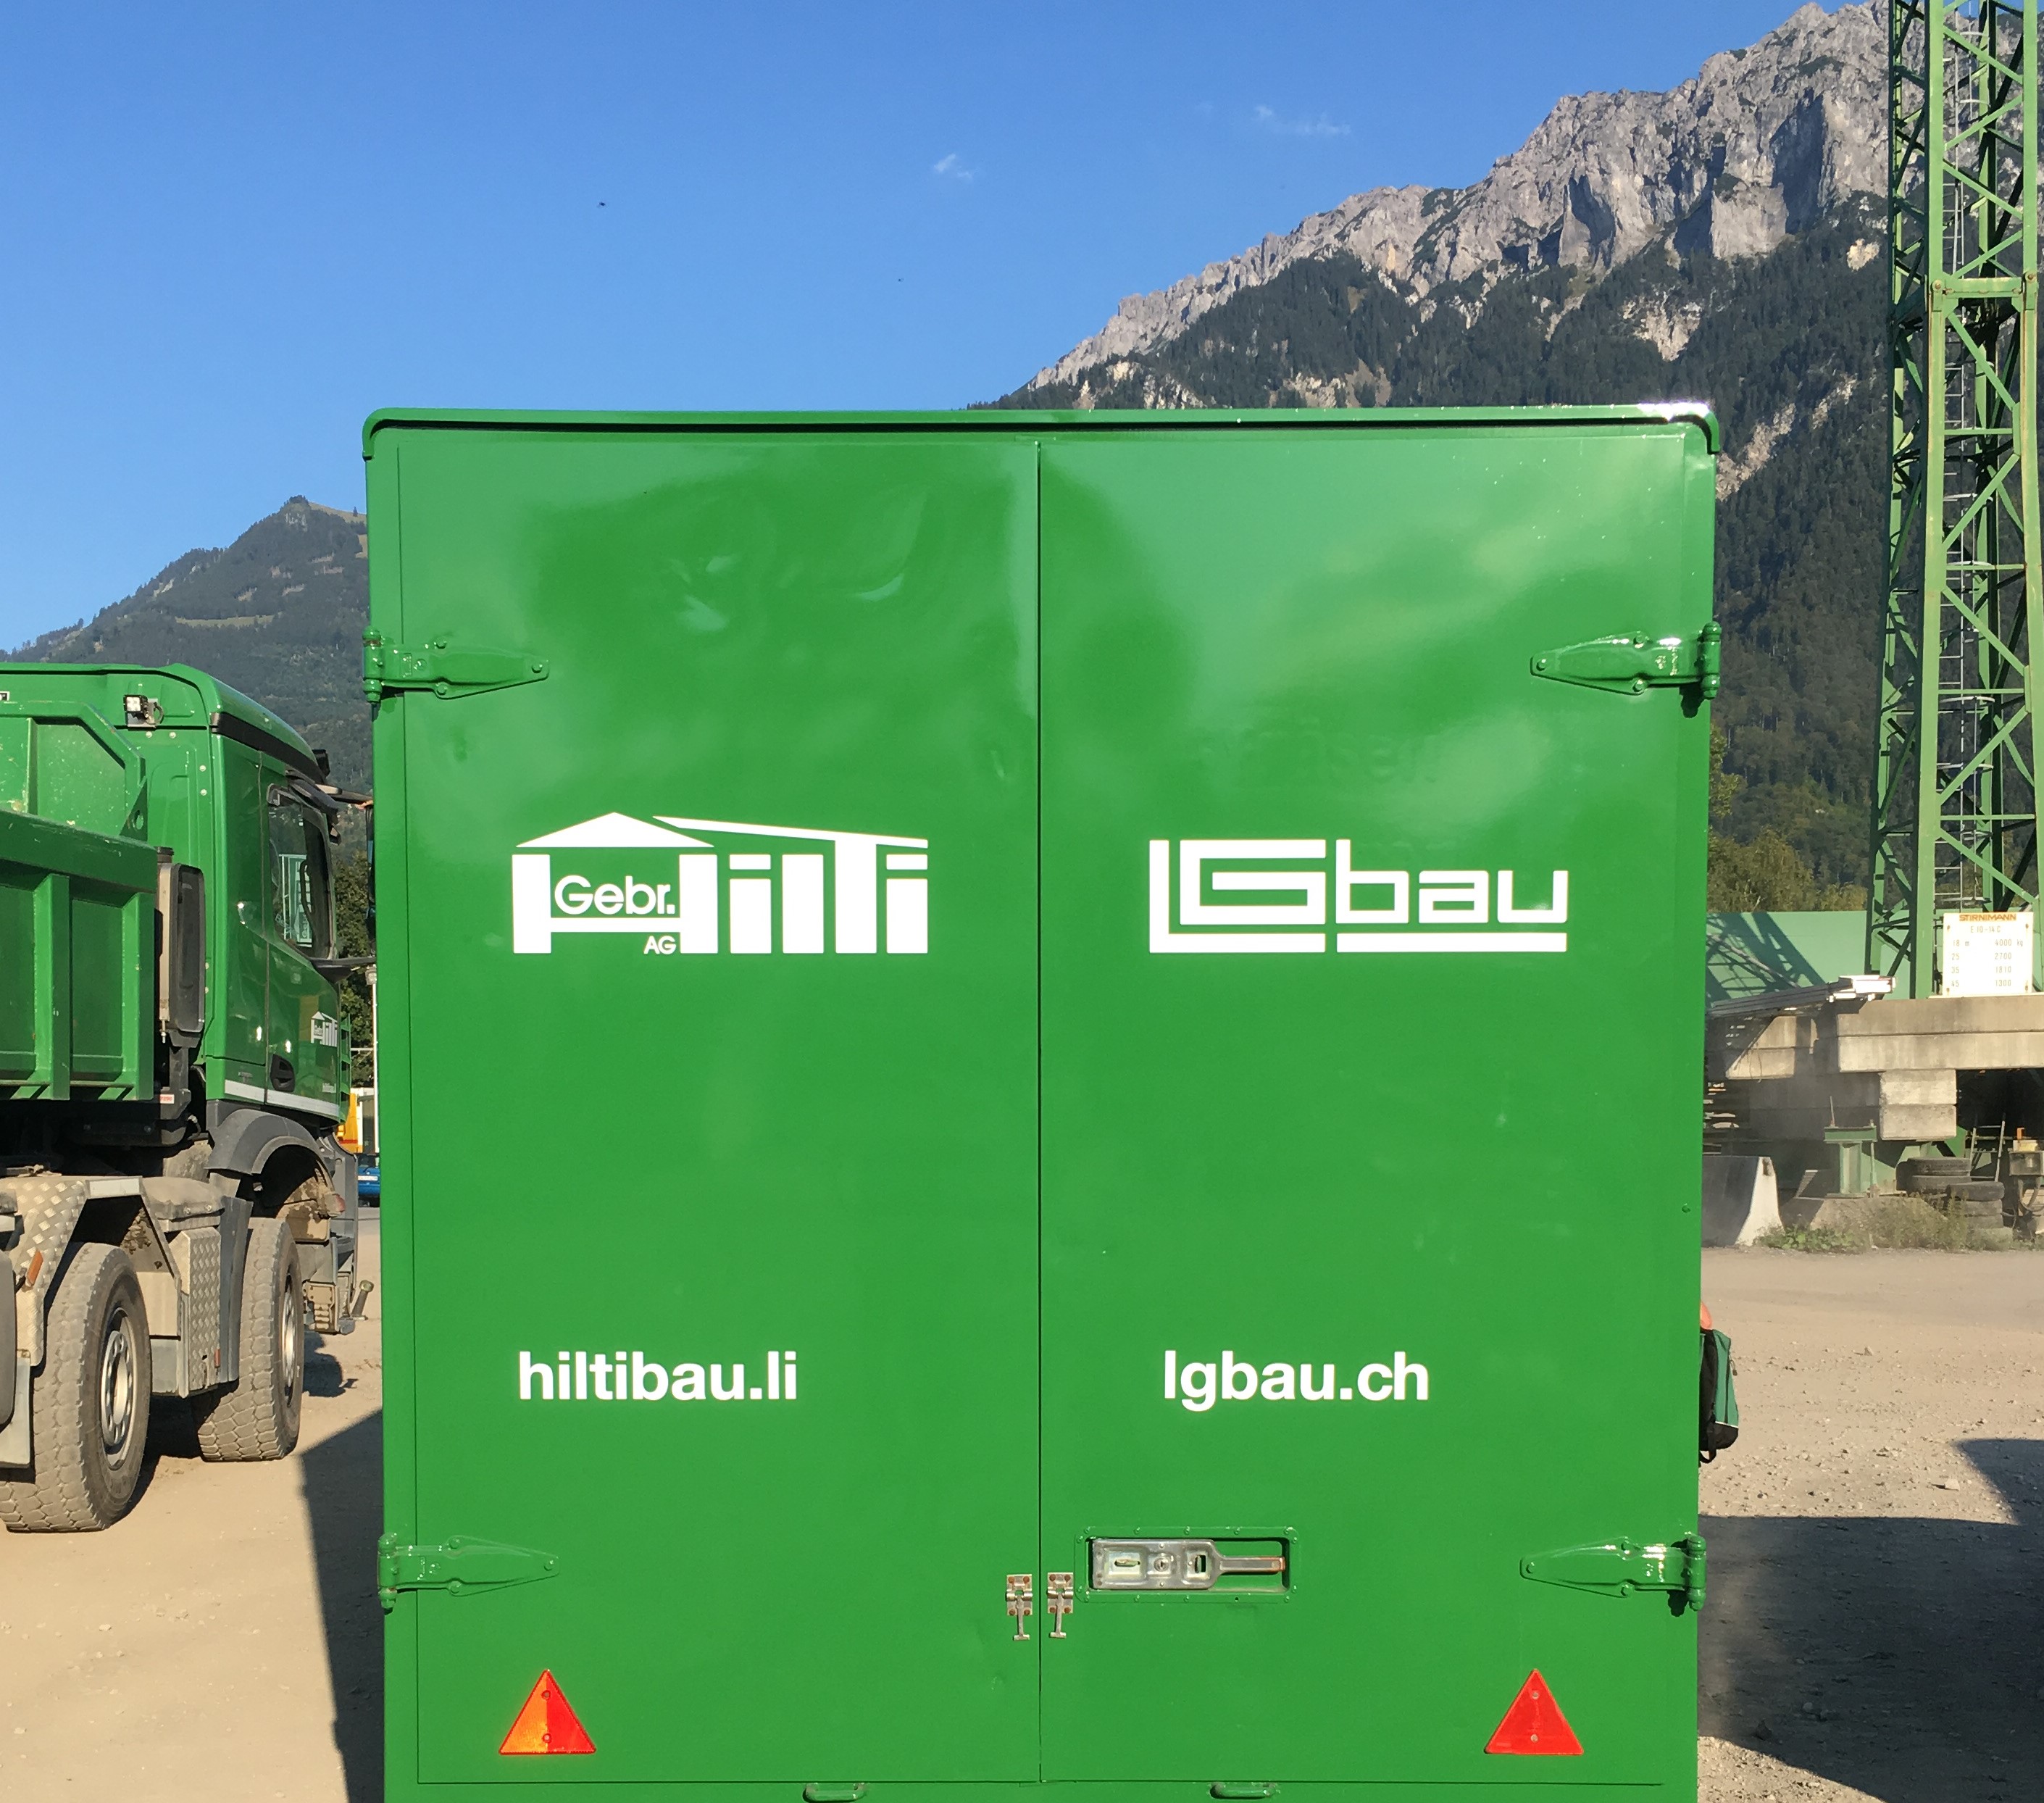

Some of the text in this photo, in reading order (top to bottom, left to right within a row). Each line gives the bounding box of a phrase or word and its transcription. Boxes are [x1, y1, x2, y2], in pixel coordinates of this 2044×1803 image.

[554, 875, 676, 915] Gebr.
[643, 936, 676, 954] AG
[1995, 965, 2011, 974] 1810
[519, 1351, 797, 1401] hiltibau.li
[1164, 1350, 1428, 1412] lgbau.ch
